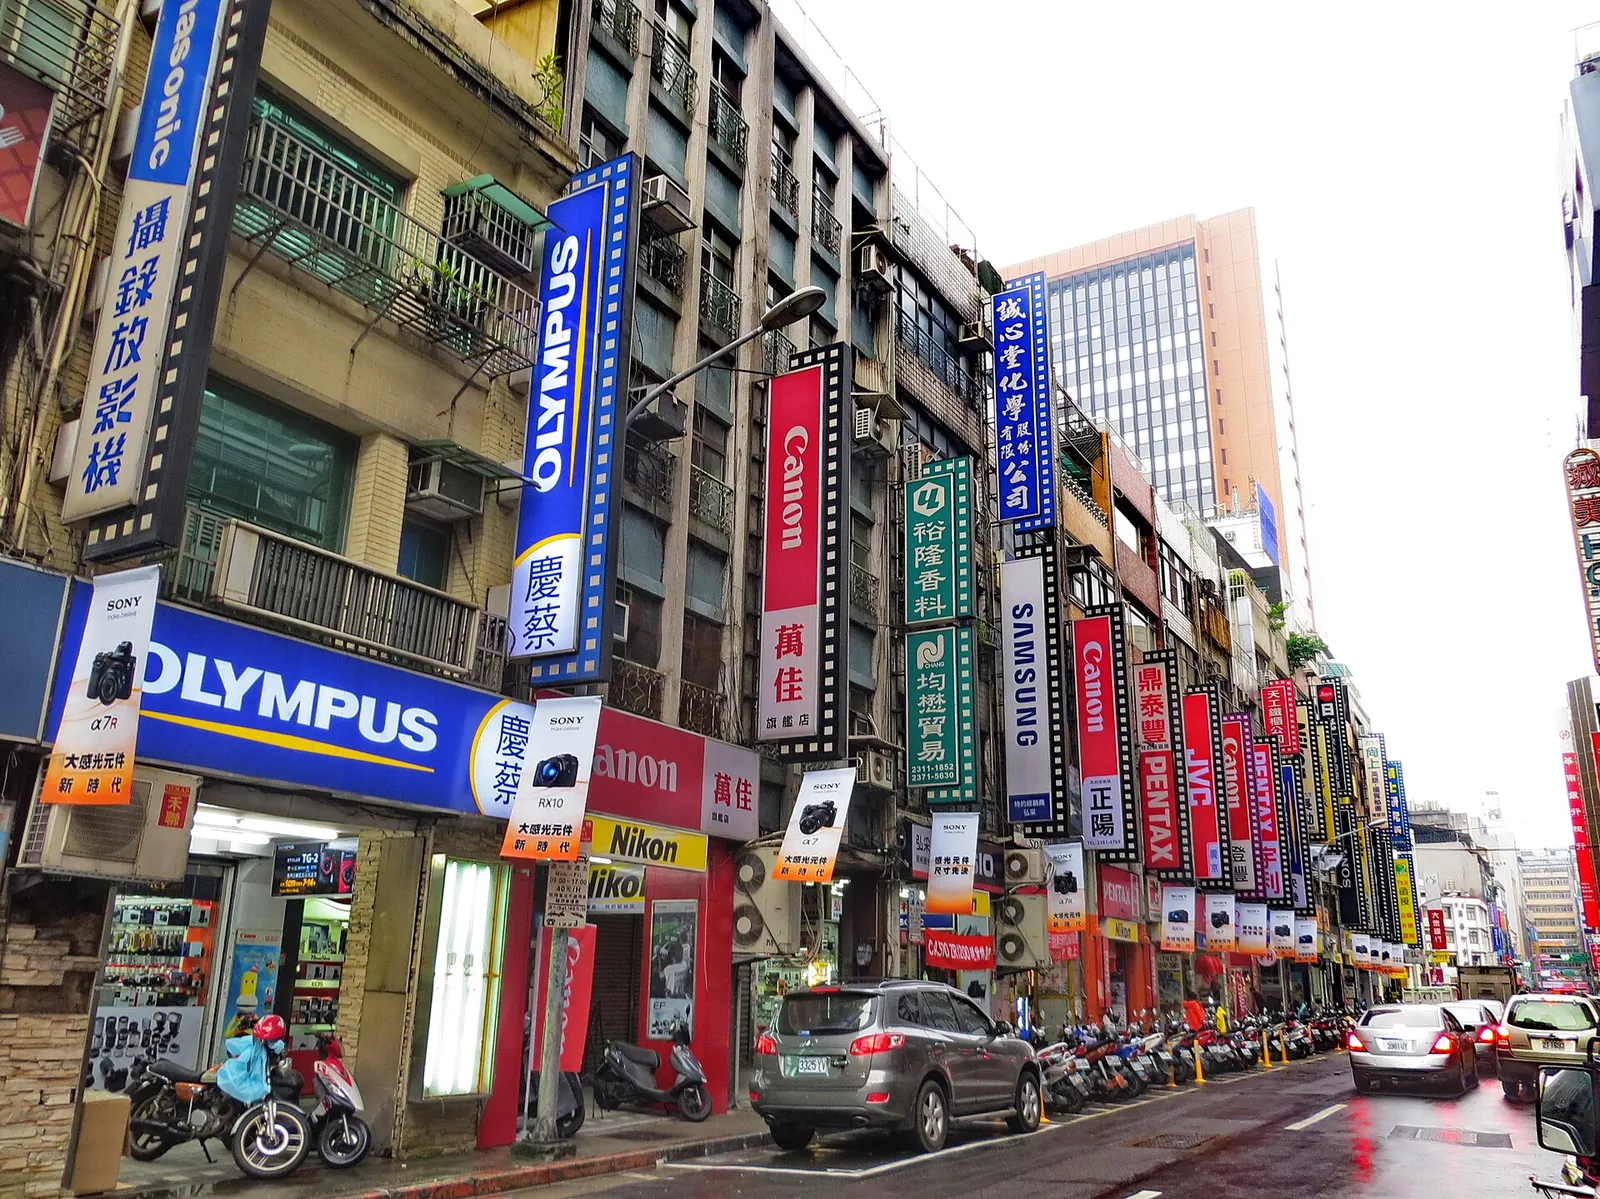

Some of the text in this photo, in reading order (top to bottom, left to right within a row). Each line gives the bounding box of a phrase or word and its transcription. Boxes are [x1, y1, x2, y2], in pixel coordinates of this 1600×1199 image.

[82, 195, 173, 495] 攝錄放影機
[532, 233, 579, 493] OLYMPUS
[996, 298, 1028, 422] 誠心堂化學
[781, 425, 809, 550] Canon
[913, 520, 947, 618] 裕隆香料
[106, 595, 142, 612] SONY
[524, 555, 563, 651] 慶蔡
[774, 622, 804, 704] 萬佳
[924, 661, 945, 669] CHANG
[1012, 602, 1038, 747] SAMSUNG
[142, 641, 439, 752] OLYMPUS
[1082, 640, 1104, 733] Canon
[1138, 666, 1167, 744] 鼎泰豐
[549, 715, 584, 725] SONY
[766, 714, 810, 730] 旗艦店
[65, 752, 125, 770] 大感光元件
[493, 714, 531, 805] 慶蔡
[911, 763, 954, 774] 2311-1852
[1186, 748, 1212, 807] JVC
[1222, 737, 1241, 809] Canon
[538, 798, 564, 809] RX10
[714, 771, 753, 812] 萬佳
[812, 782, 841, 791] SONY
[165, 796, 184, 827] 禾聯
[1089, 786, 1115, 838] 正陽
[1144, 755, 1173, 863] PENTAX
[518, 824, 573, 837] 大感光元件
[609, 824, 678, 864] Nikon
[302, 852, 319, 864] TG-2
[784, 855, 828, 866] 大感光元件
[933, 866, 969, 875] 尺寸先決
[934, 856, 970, 866] 感光元件
[1053, 853, 1073, 861] SONY
[1103, 881, 1131, 905] PENTAX
[653, 1002, 666, 1011] EF
